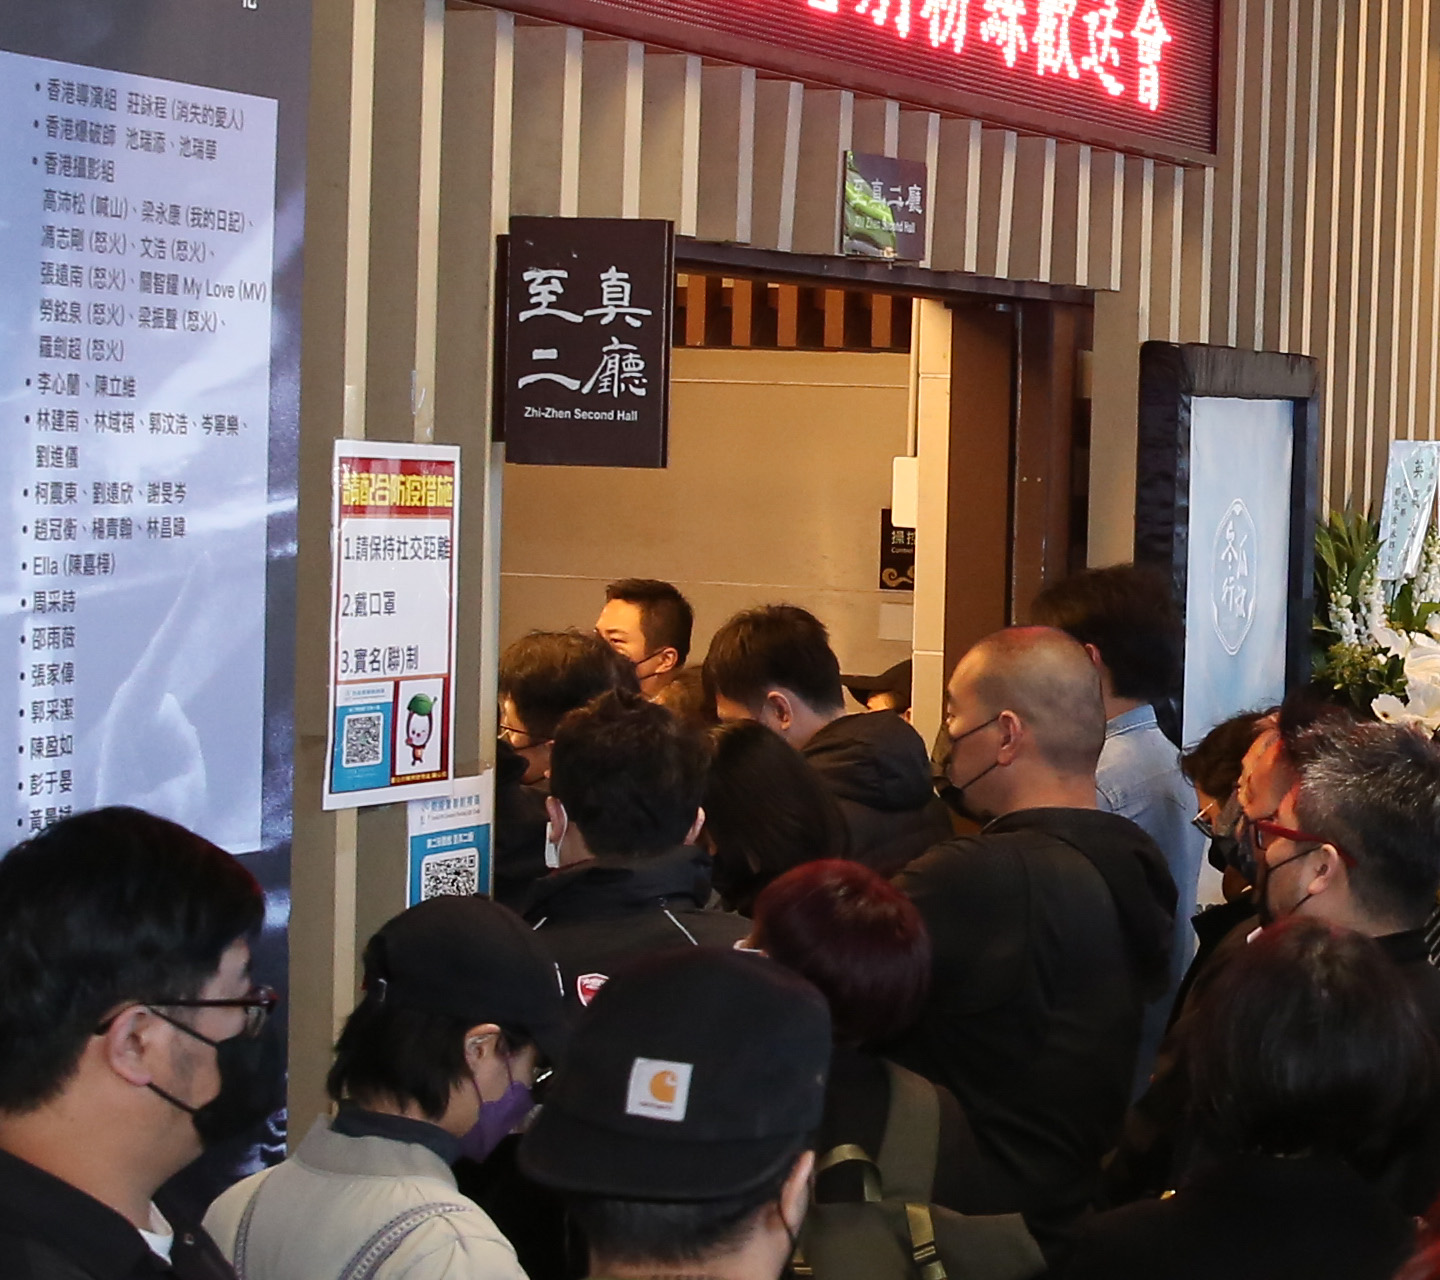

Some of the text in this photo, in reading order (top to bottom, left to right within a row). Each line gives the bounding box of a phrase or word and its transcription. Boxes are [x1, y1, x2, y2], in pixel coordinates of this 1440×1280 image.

[46, 78, 117, 112] 香港導演組
[171, 99, 244, 131] (消失的愛人)
[45, 115, 116, 148] 香港爆破師
[45, 152, 115, 183] 香港攝影組
[183, 277, 202, 300] My
[206, 279, 235, 299] Love
[239, 280, 266, 302] (MV)
[87, 338, 124, 361] (怒火)
[524, 406, 638, 421] Zhi-Zhen Second Hall
[342, 473, 453, 507] 請配合防疫措施
[344, 536, 450, 561] 1.請保持社交距離
[33, 556, 58, 576] Ella
[342, 591, 396, 617] 2.戴口罩
[31, 626, 75, 651] 邵雨薇
[31, 698, 74, 724] 郭采潔
[30, 769, 72, 796] 彭于晏
